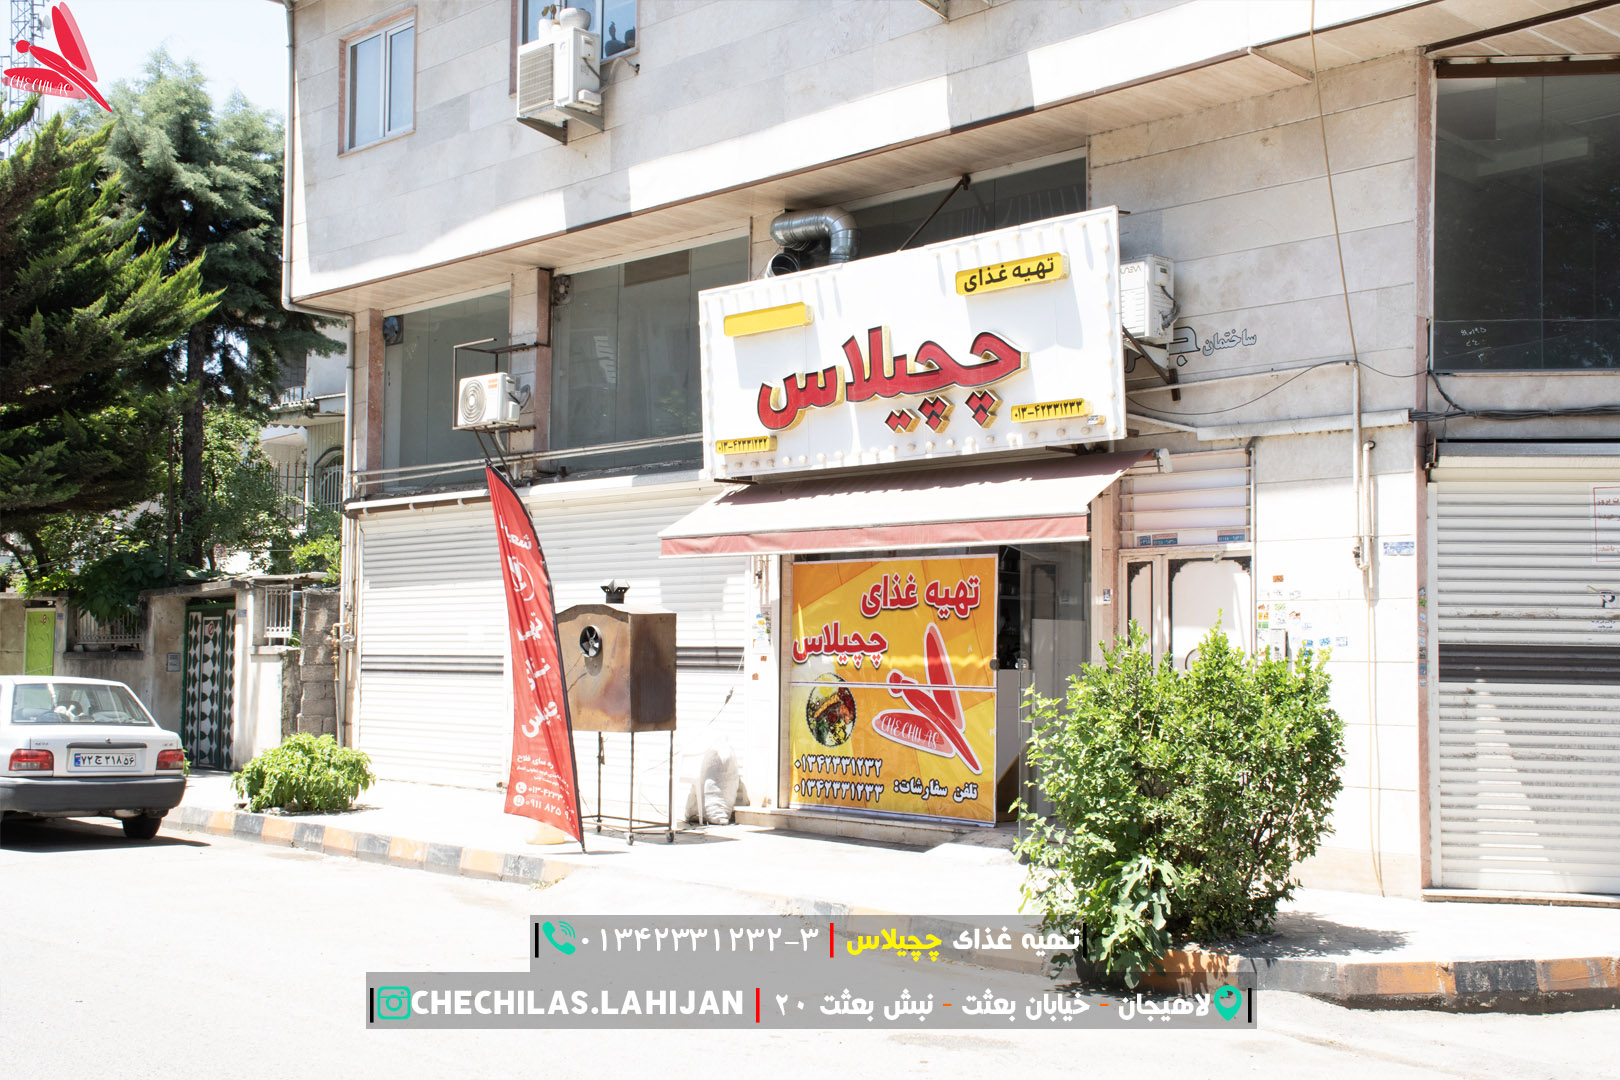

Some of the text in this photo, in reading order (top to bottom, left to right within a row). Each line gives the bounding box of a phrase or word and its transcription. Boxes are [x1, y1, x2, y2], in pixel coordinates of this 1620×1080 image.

[964, 257, 1054, 292] تهیه غذای
[1203, 329, 1257, 356] ساختمان
[756, 325, 1024, 433] چچیلاس
[860, 572, 981, 618] تهیه غذای
[792, 621, 888, 668] چچیلاس
[794, 754, 882, 778] ۰۱۳۴۲۳۳۱۲۳۲
[794, 777, 978, 803] تلفن سفارشات: ۰۱۳۴۲۳۳۱۲۳۳
